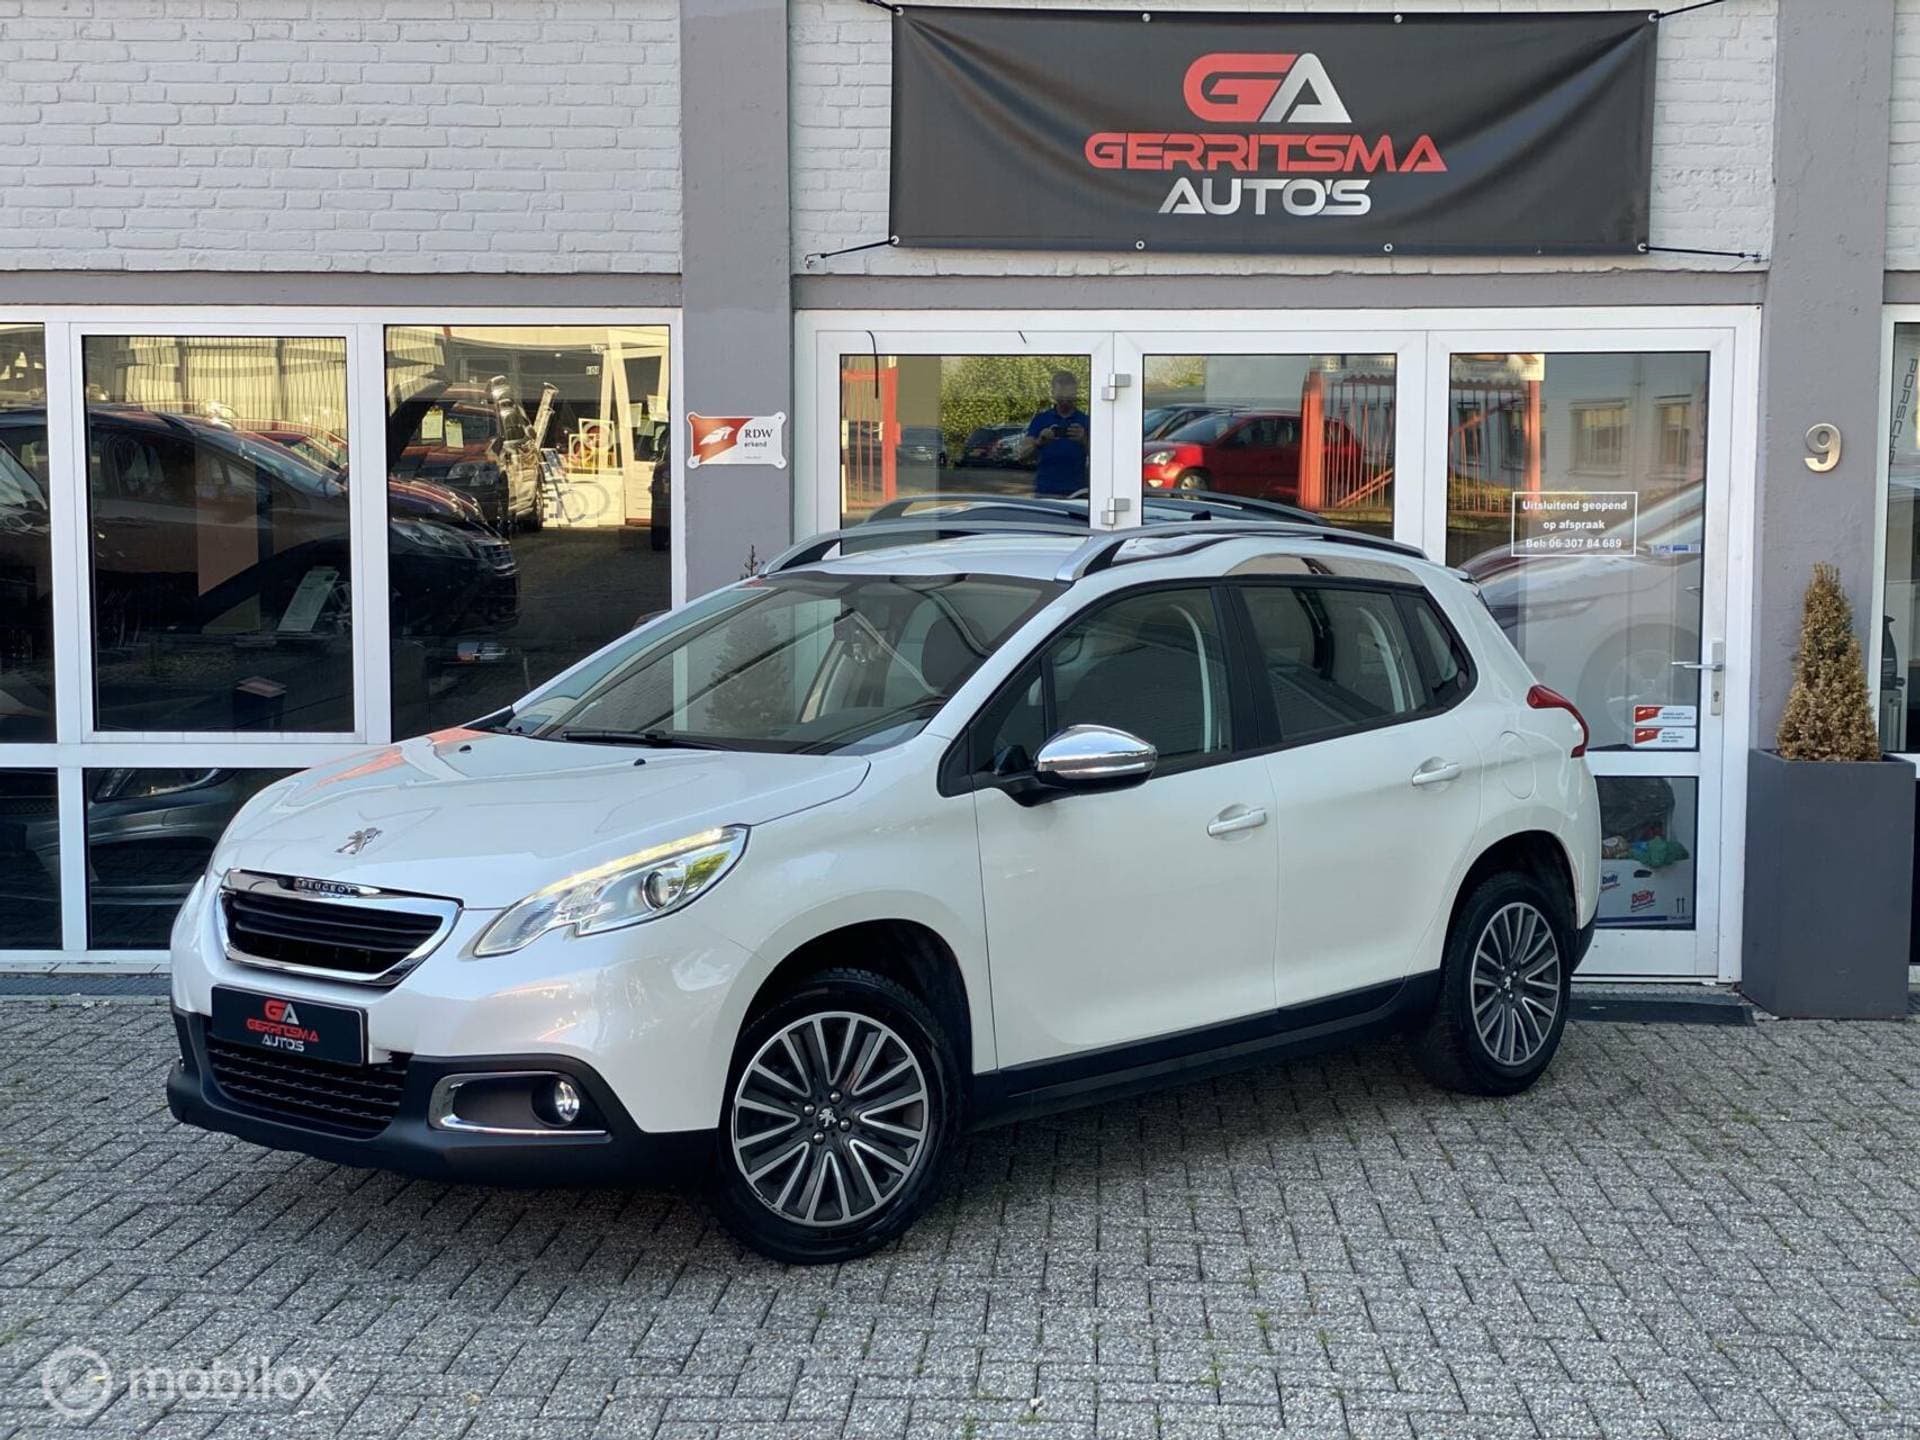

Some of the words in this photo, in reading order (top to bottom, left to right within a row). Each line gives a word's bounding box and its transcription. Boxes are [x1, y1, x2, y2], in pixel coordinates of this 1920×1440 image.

[1183, 52, 1352, 123] GA
[1085, 132, 1448, 173] GERRITSMA
[1158, 177, 1372, 216] AUTO'S
[744, 428, 773, 439] RDW
[1804, 422, 1842, 473] 9
[1522, 501, 1580, 511] Uitsluitend
[1582, 501, 1628, 512] geopend
[1543, 521, 1556, 531] op
[1558, 520, 1605, 530] afspraak
[1526, 539, 1545, 548] Bel:
[1548, 539, 1561, 548] 06
[1564, 538, 1583, 548] 307
[1586, 538, 1600, 548] 84
[1602, 538, 1622, 548] 689
[300, 879, 353, 893] PEUGEOT
[264, 1000, 299, 1024] GA
[246, 1018, 319, 1042] GERRITSMA
